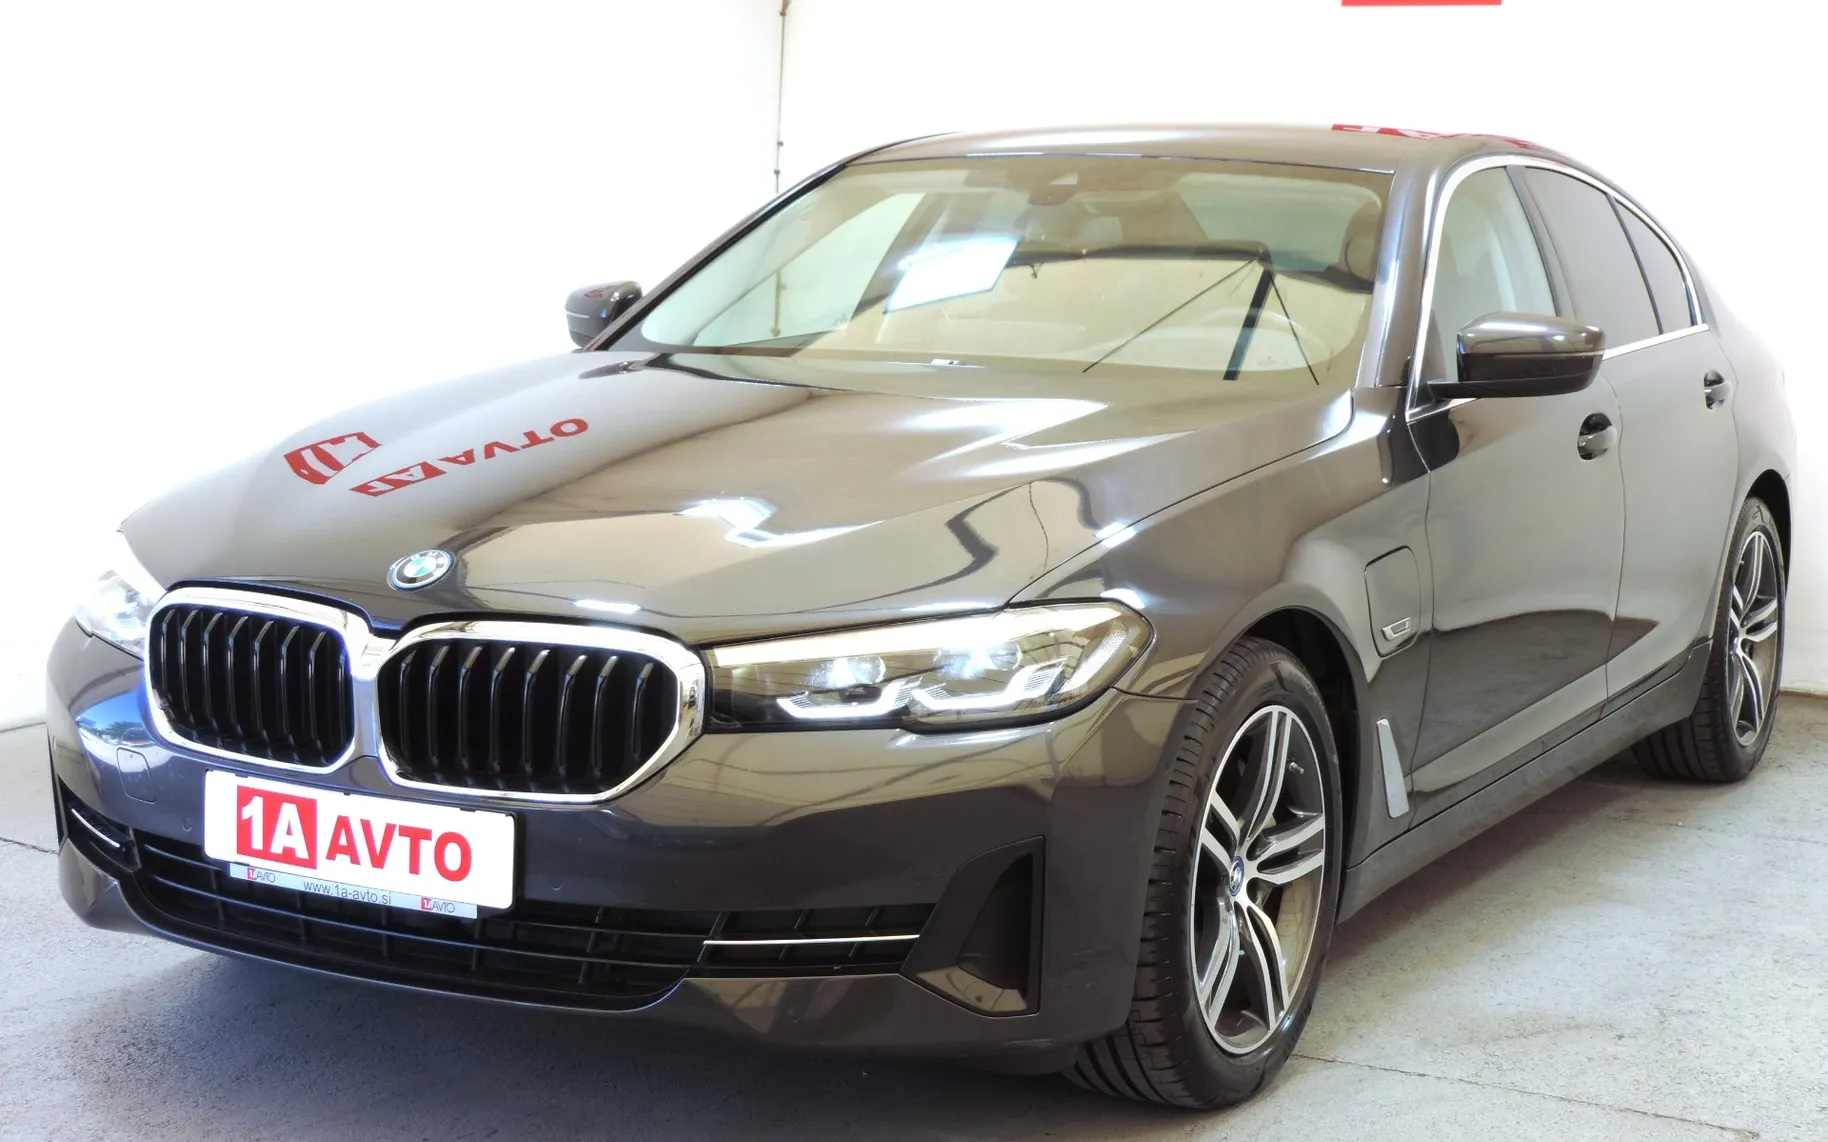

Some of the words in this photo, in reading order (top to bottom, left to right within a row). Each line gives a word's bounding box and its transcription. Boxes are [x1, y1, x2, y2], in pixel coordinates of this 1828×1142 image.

[241, 795, 309, 859] 1A
[325, 814, 472, 882] AVTO
[303, 880, 392, 905] www.1a-avto.si
